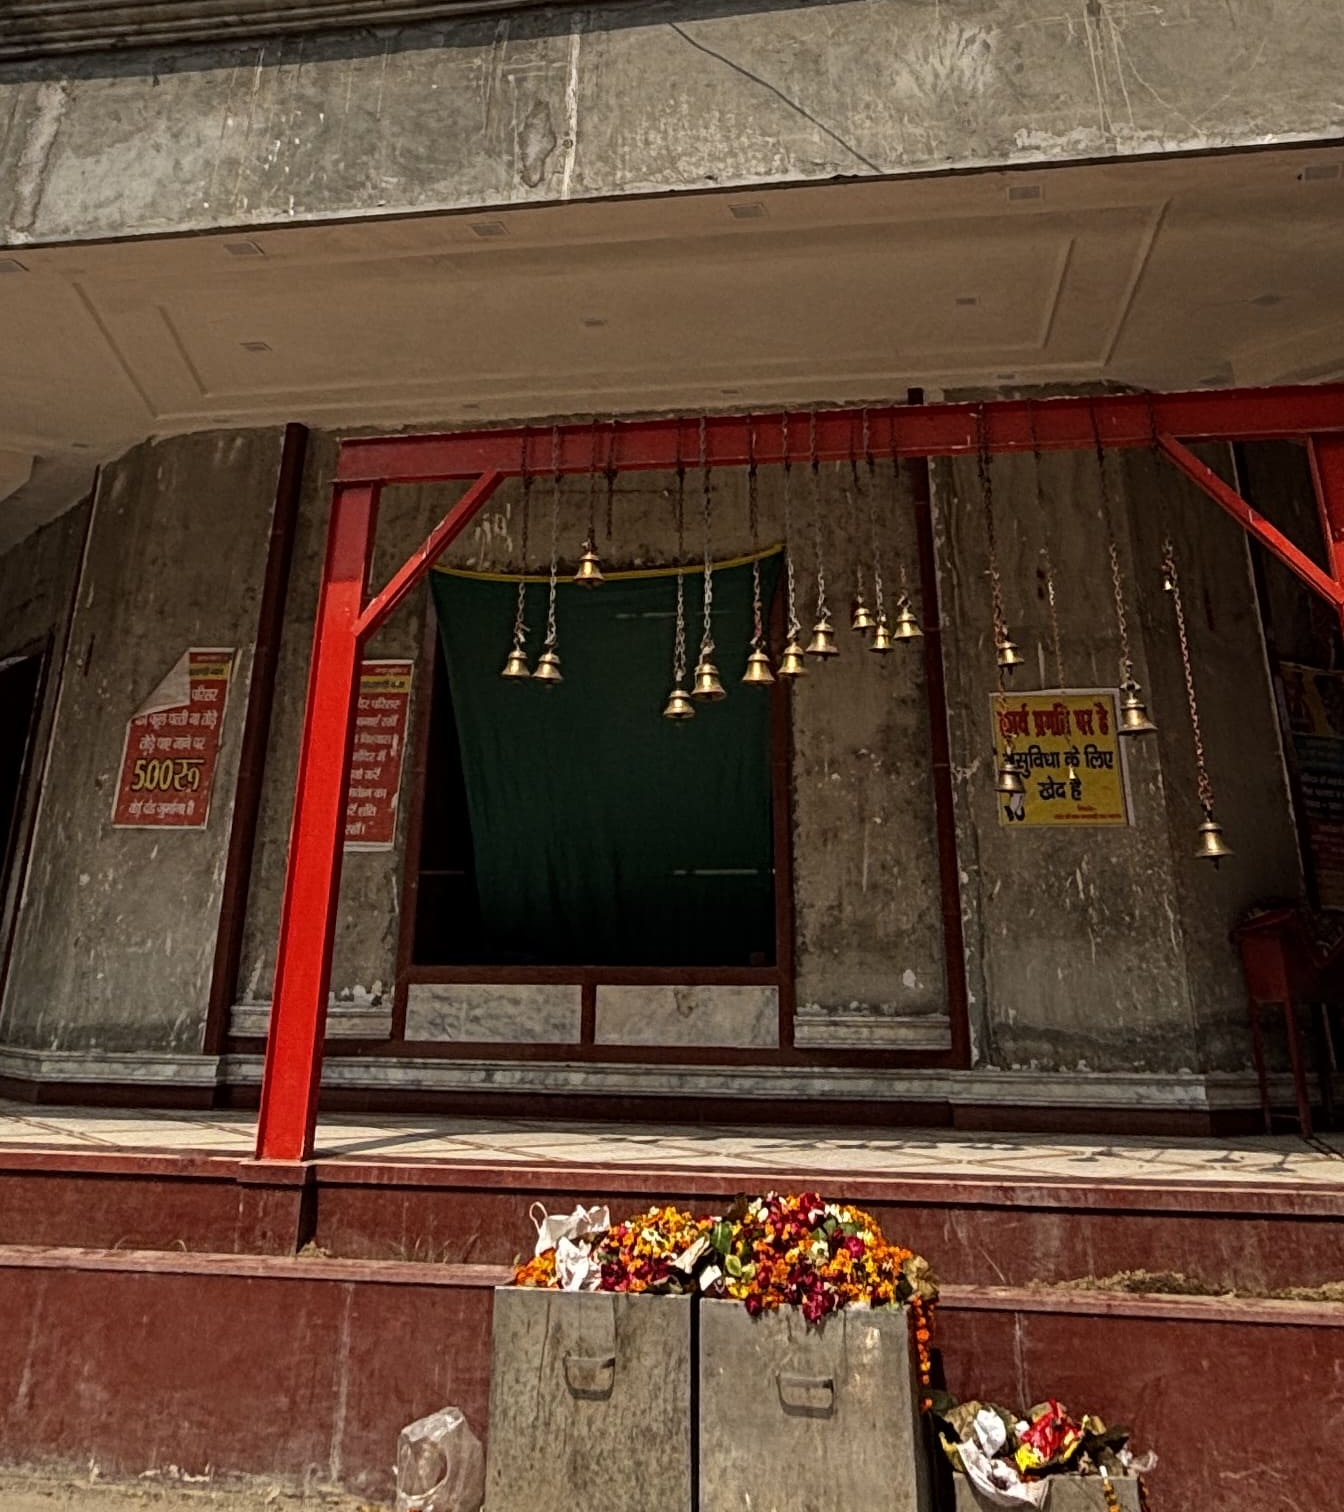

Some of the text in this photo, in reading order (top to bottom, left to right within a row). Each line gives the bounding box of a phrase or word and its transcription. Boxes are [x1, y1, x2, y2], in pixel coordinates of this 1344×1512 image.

[1073, 709, 1094, 736] पर
[1094, 701, 1109, 736] है
[1063, 745, 1080, 767] के
[1084, 744, 1114, 770] लिए
[1037, 775, 1082, 801] खेद है
